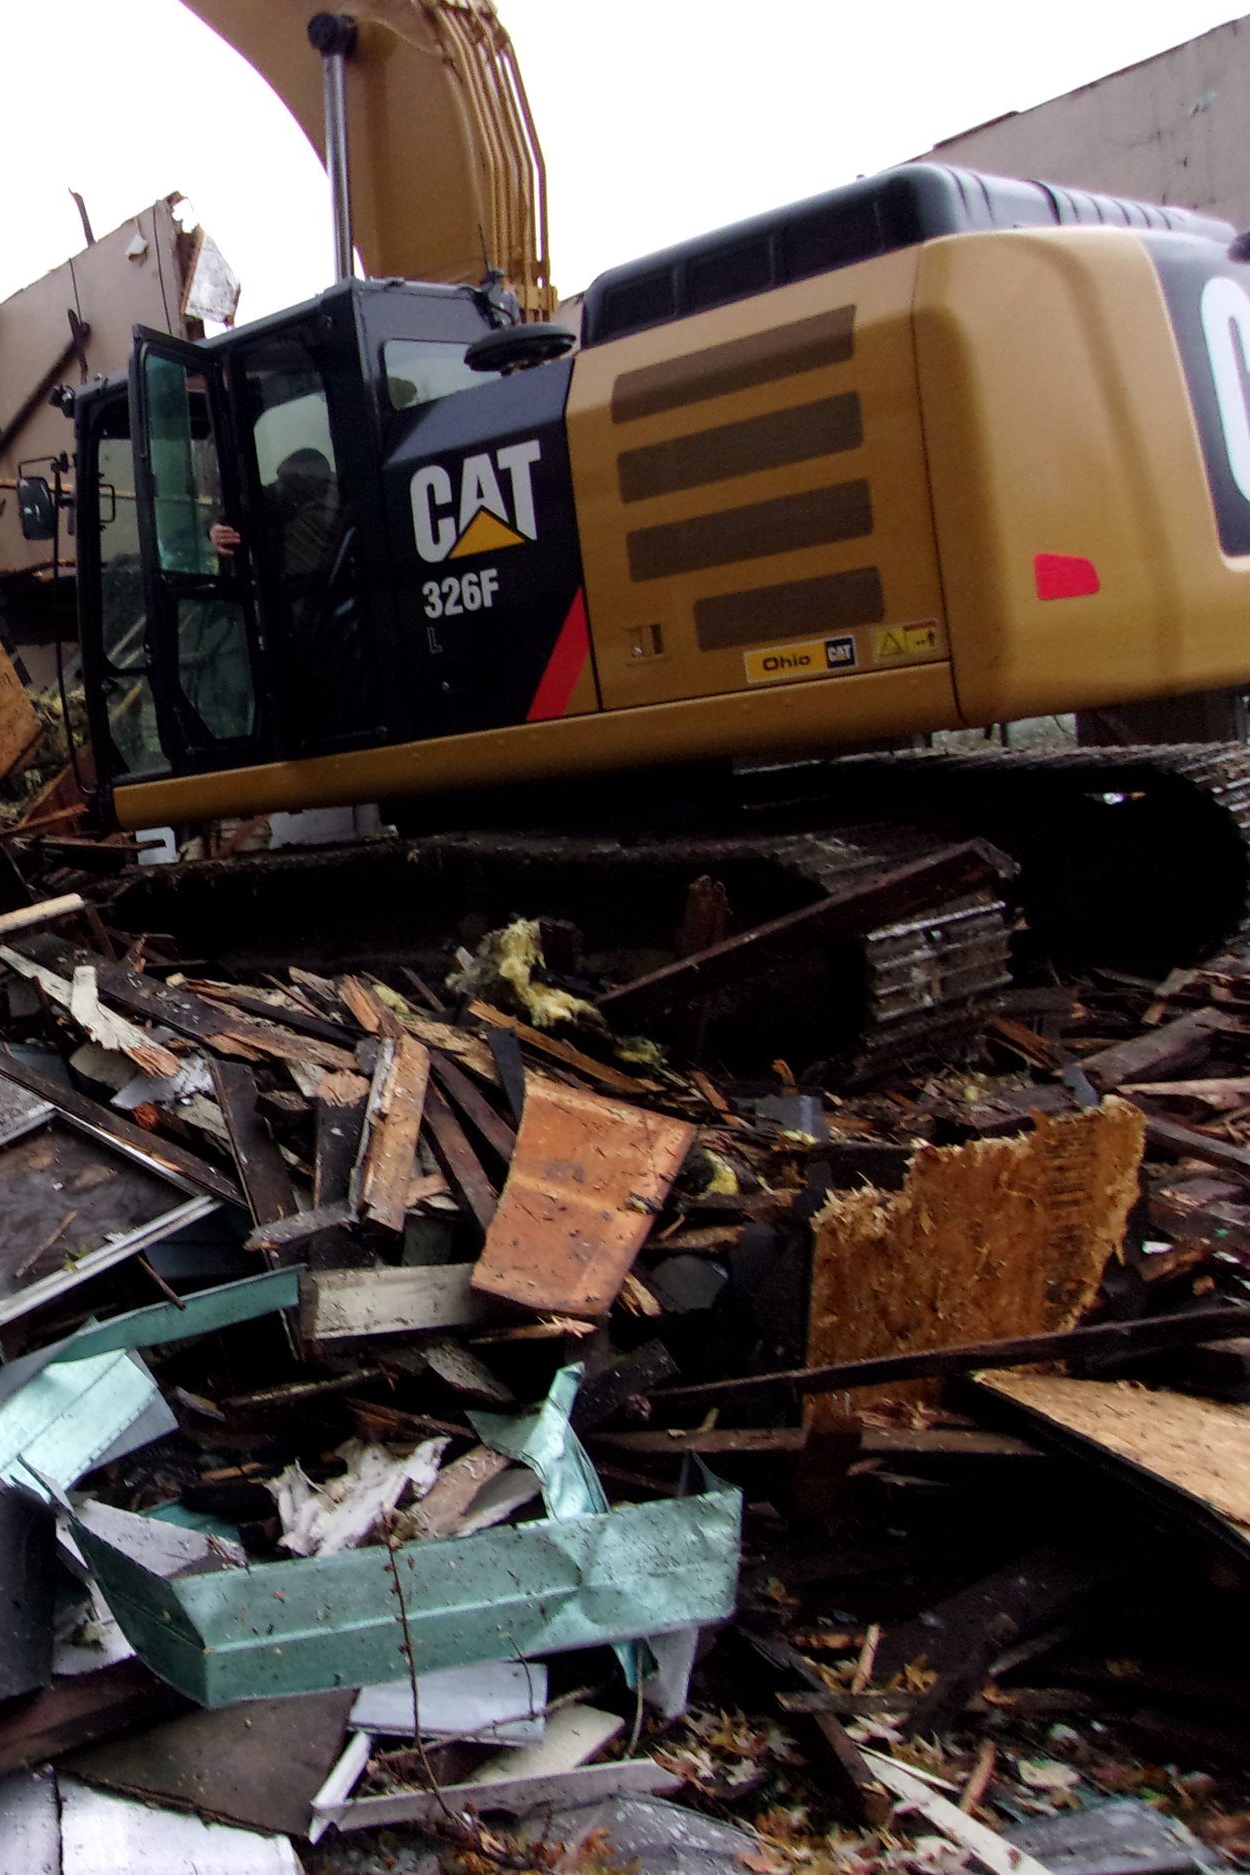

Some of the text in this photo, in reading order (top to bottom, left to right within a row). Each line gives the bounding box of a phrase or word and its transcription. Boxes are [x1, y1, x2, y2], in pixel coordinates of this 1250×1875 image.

[410, 440, 541, 563] CAT
[422, 569, 499, 619] 326F
[762, 644, 854, 671] Ohio CAT
